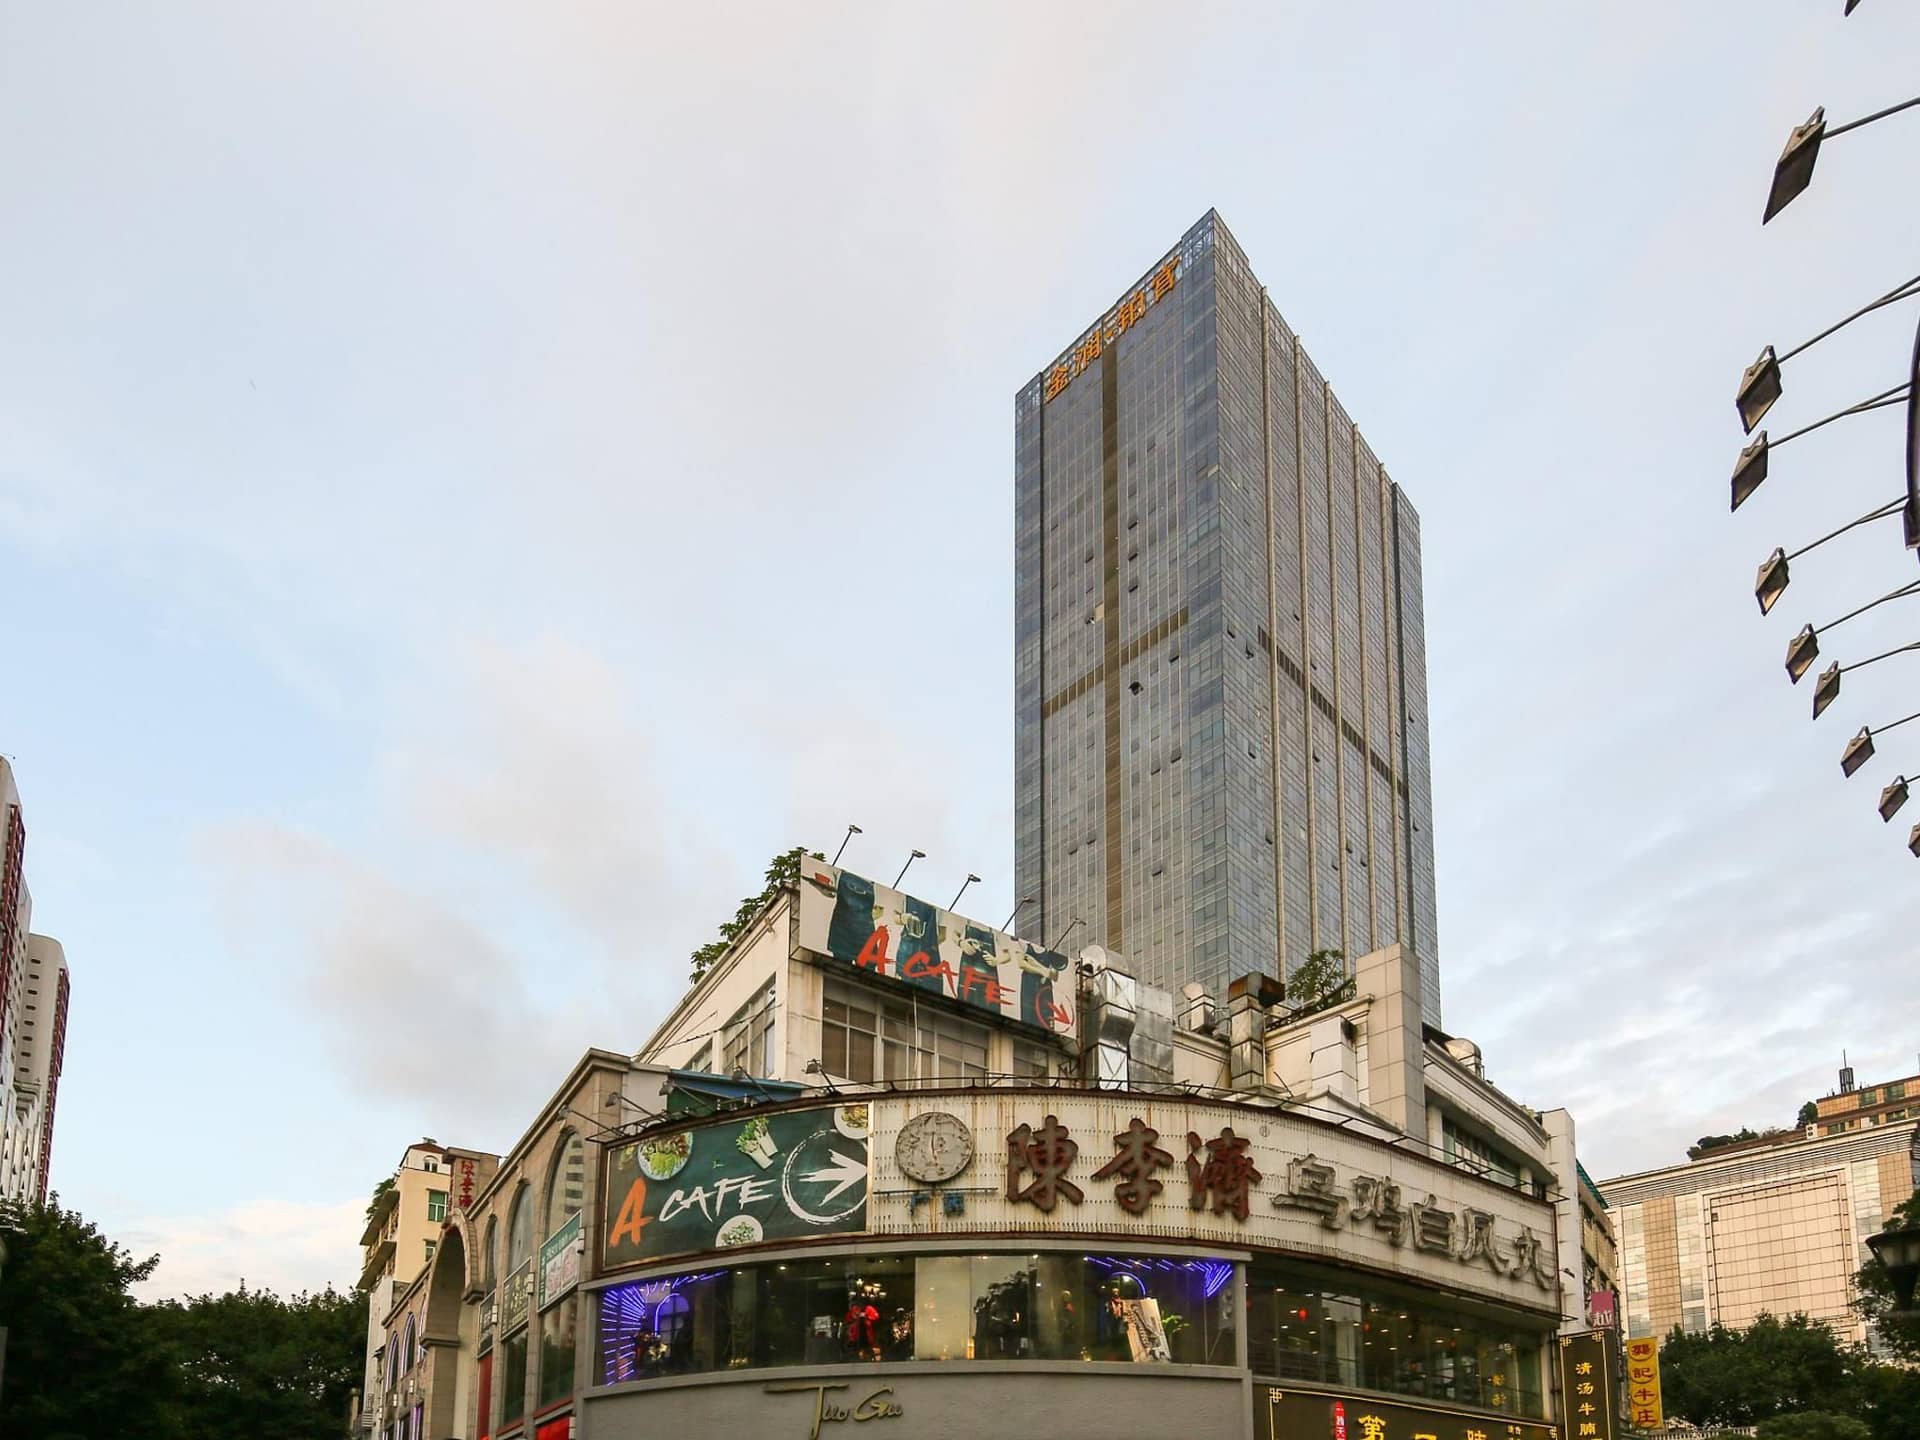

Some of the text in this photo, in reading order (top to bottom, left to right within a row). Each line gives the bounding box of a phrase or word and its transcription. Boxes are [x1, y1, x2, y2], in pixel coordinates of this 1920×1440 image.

[856, 924, 1016, 1006] A CAFE
[1006, 1114, 1262, 1222] 陳李濟
[609, 1174, 777, 1247] A CAFE
